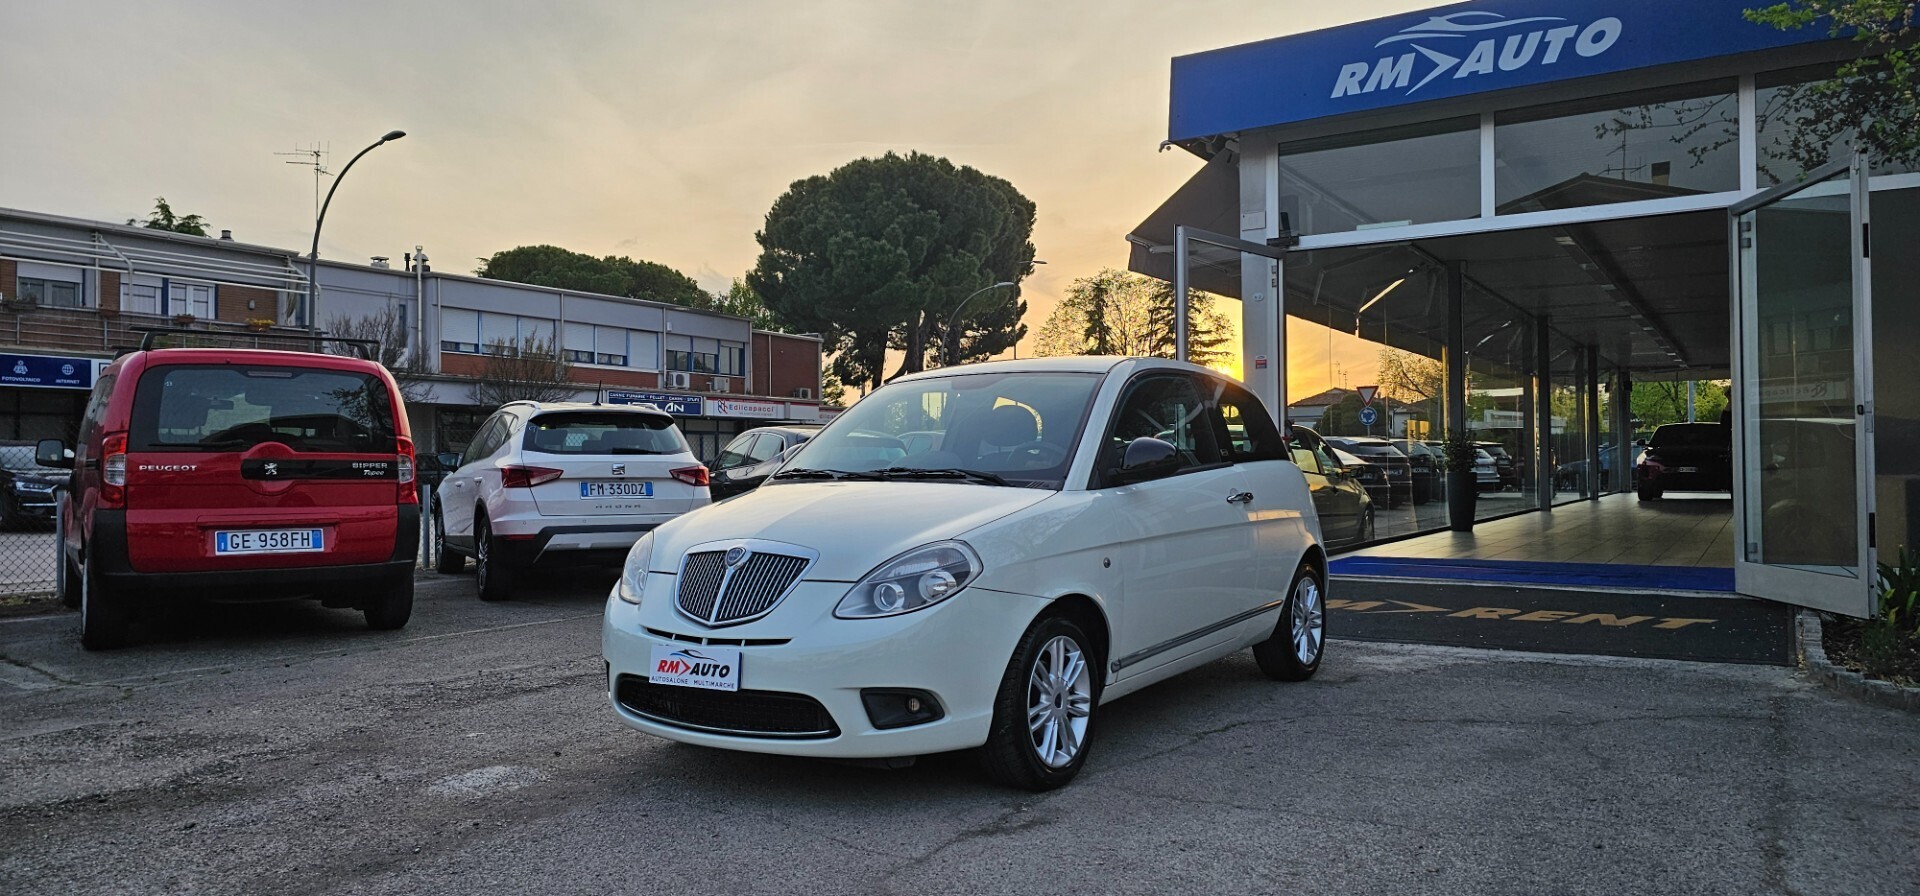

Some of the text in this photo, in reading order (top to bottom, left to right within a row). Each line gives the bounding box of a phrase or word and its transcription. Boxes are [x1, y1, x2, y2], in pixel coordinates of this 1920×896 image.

[1330, 16, 1622, 98] RM AUTO
[1, 375, 41, 383] FOTOVOLTAICO
[589, 483, 645, 495] FM 330DZ
[230, 532, 310, 549] GE 958FH
[1446, 607, 1718, 629] RENT
[657, 659, 730, 678] RM AUTO
[651, 675, 735, 689] AUTOSALONE MULTIMARCHE
